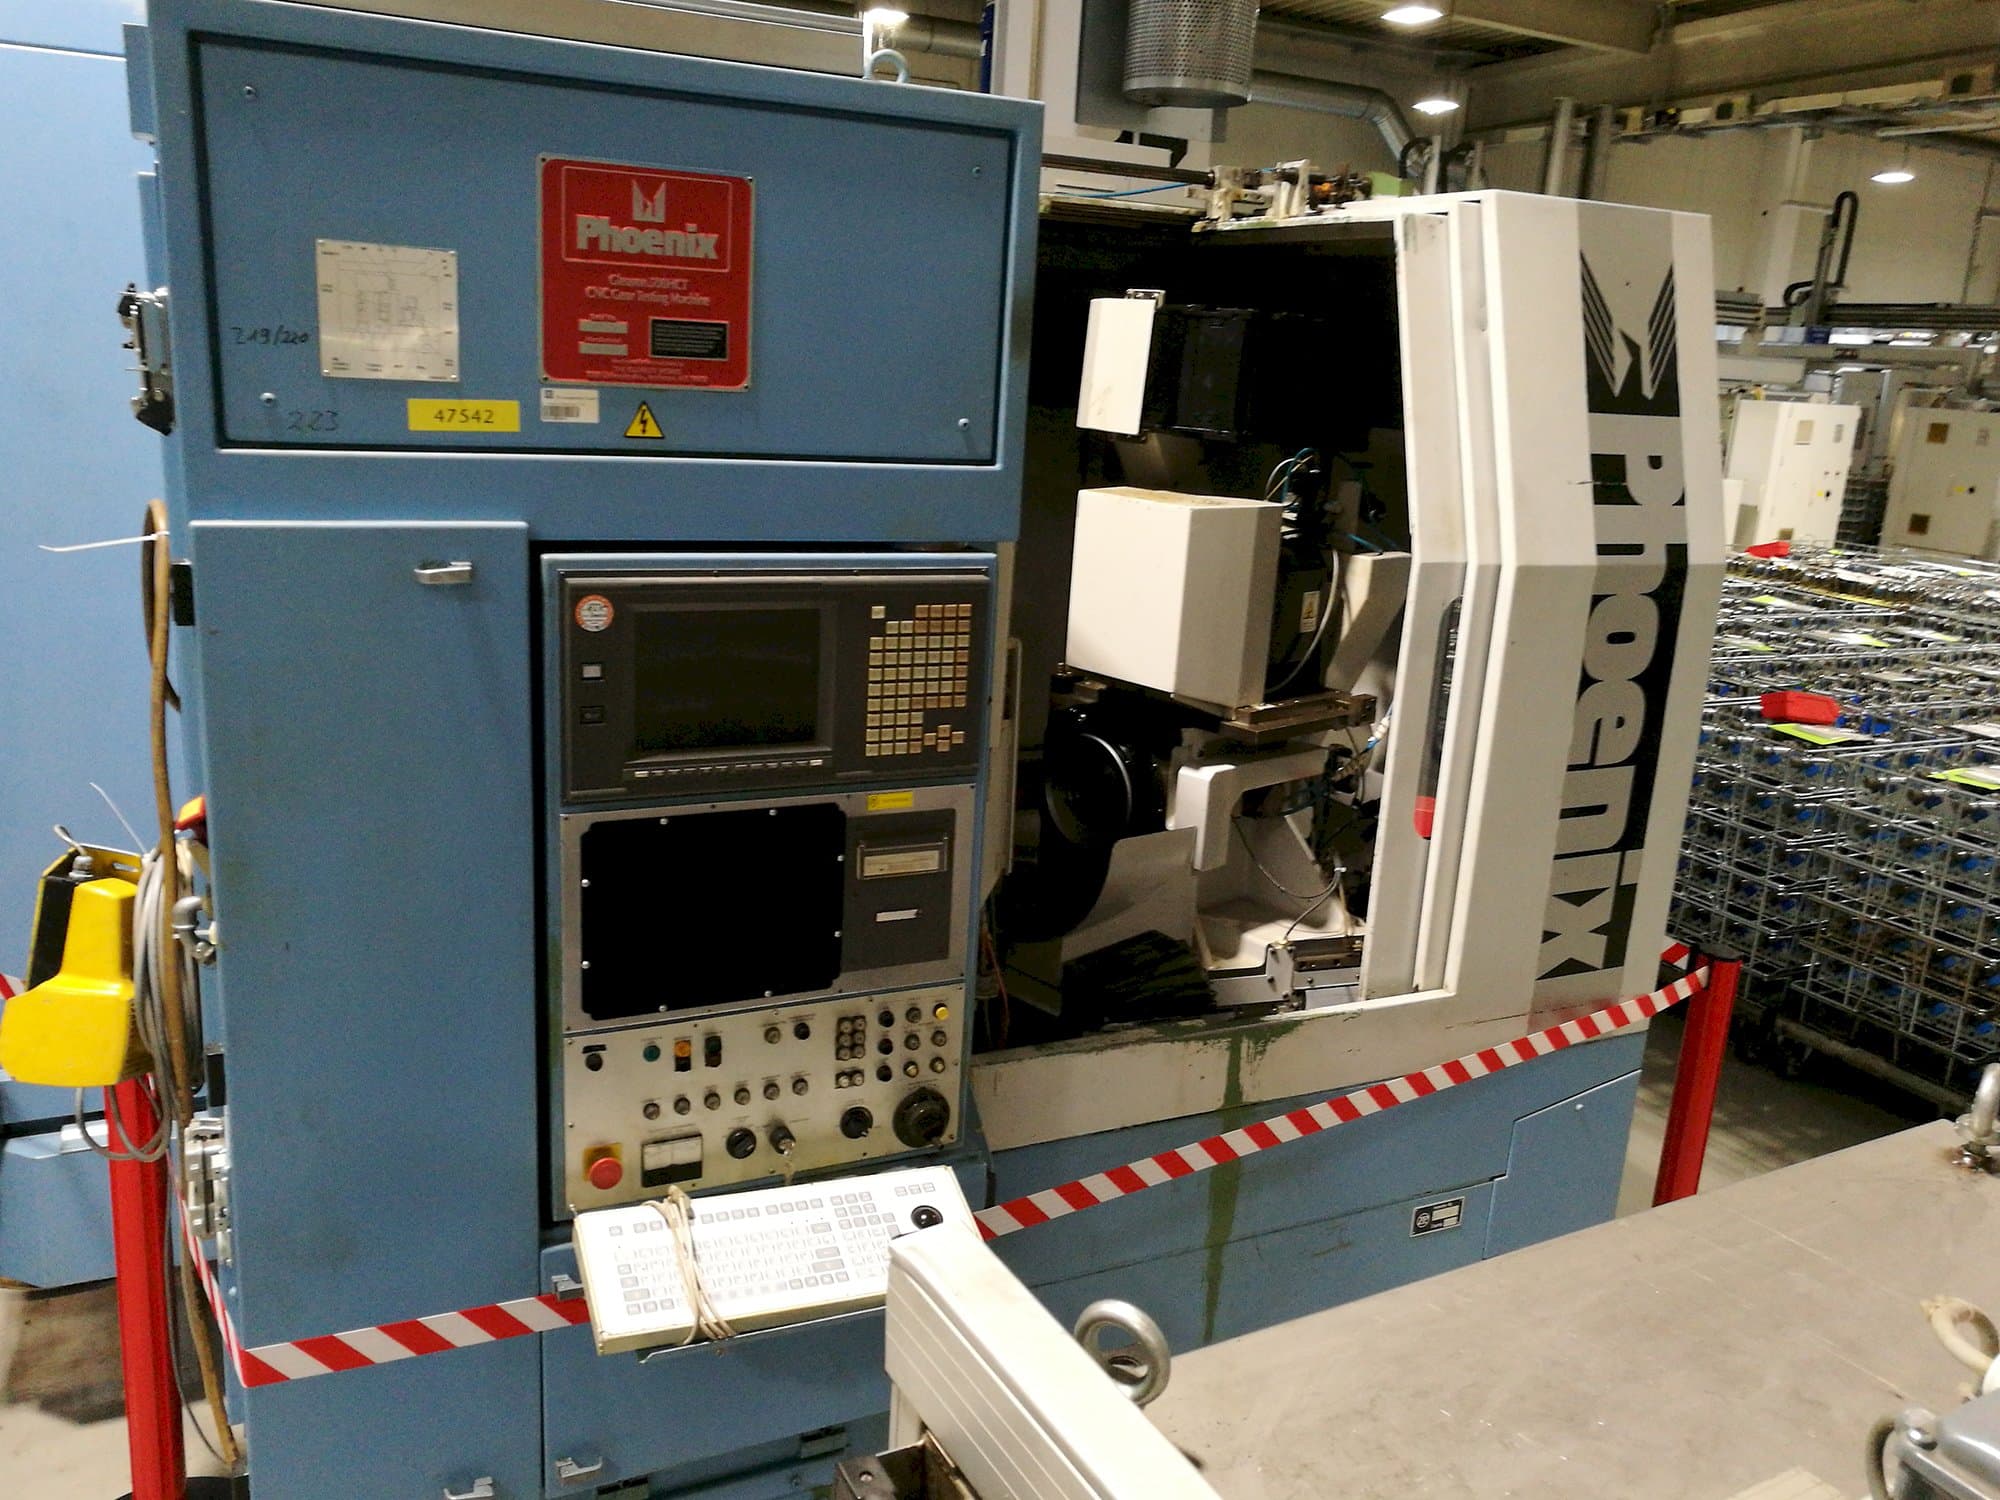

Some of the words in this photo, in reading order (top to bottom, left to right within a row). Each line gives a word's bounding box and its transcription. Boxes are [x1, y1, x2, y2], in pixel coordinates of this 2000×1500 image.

[576, 213, 719, 260] Phoenix
[434, 408, 495, 424] 47542
[1535, 412, 1688, 980] Phoenix
